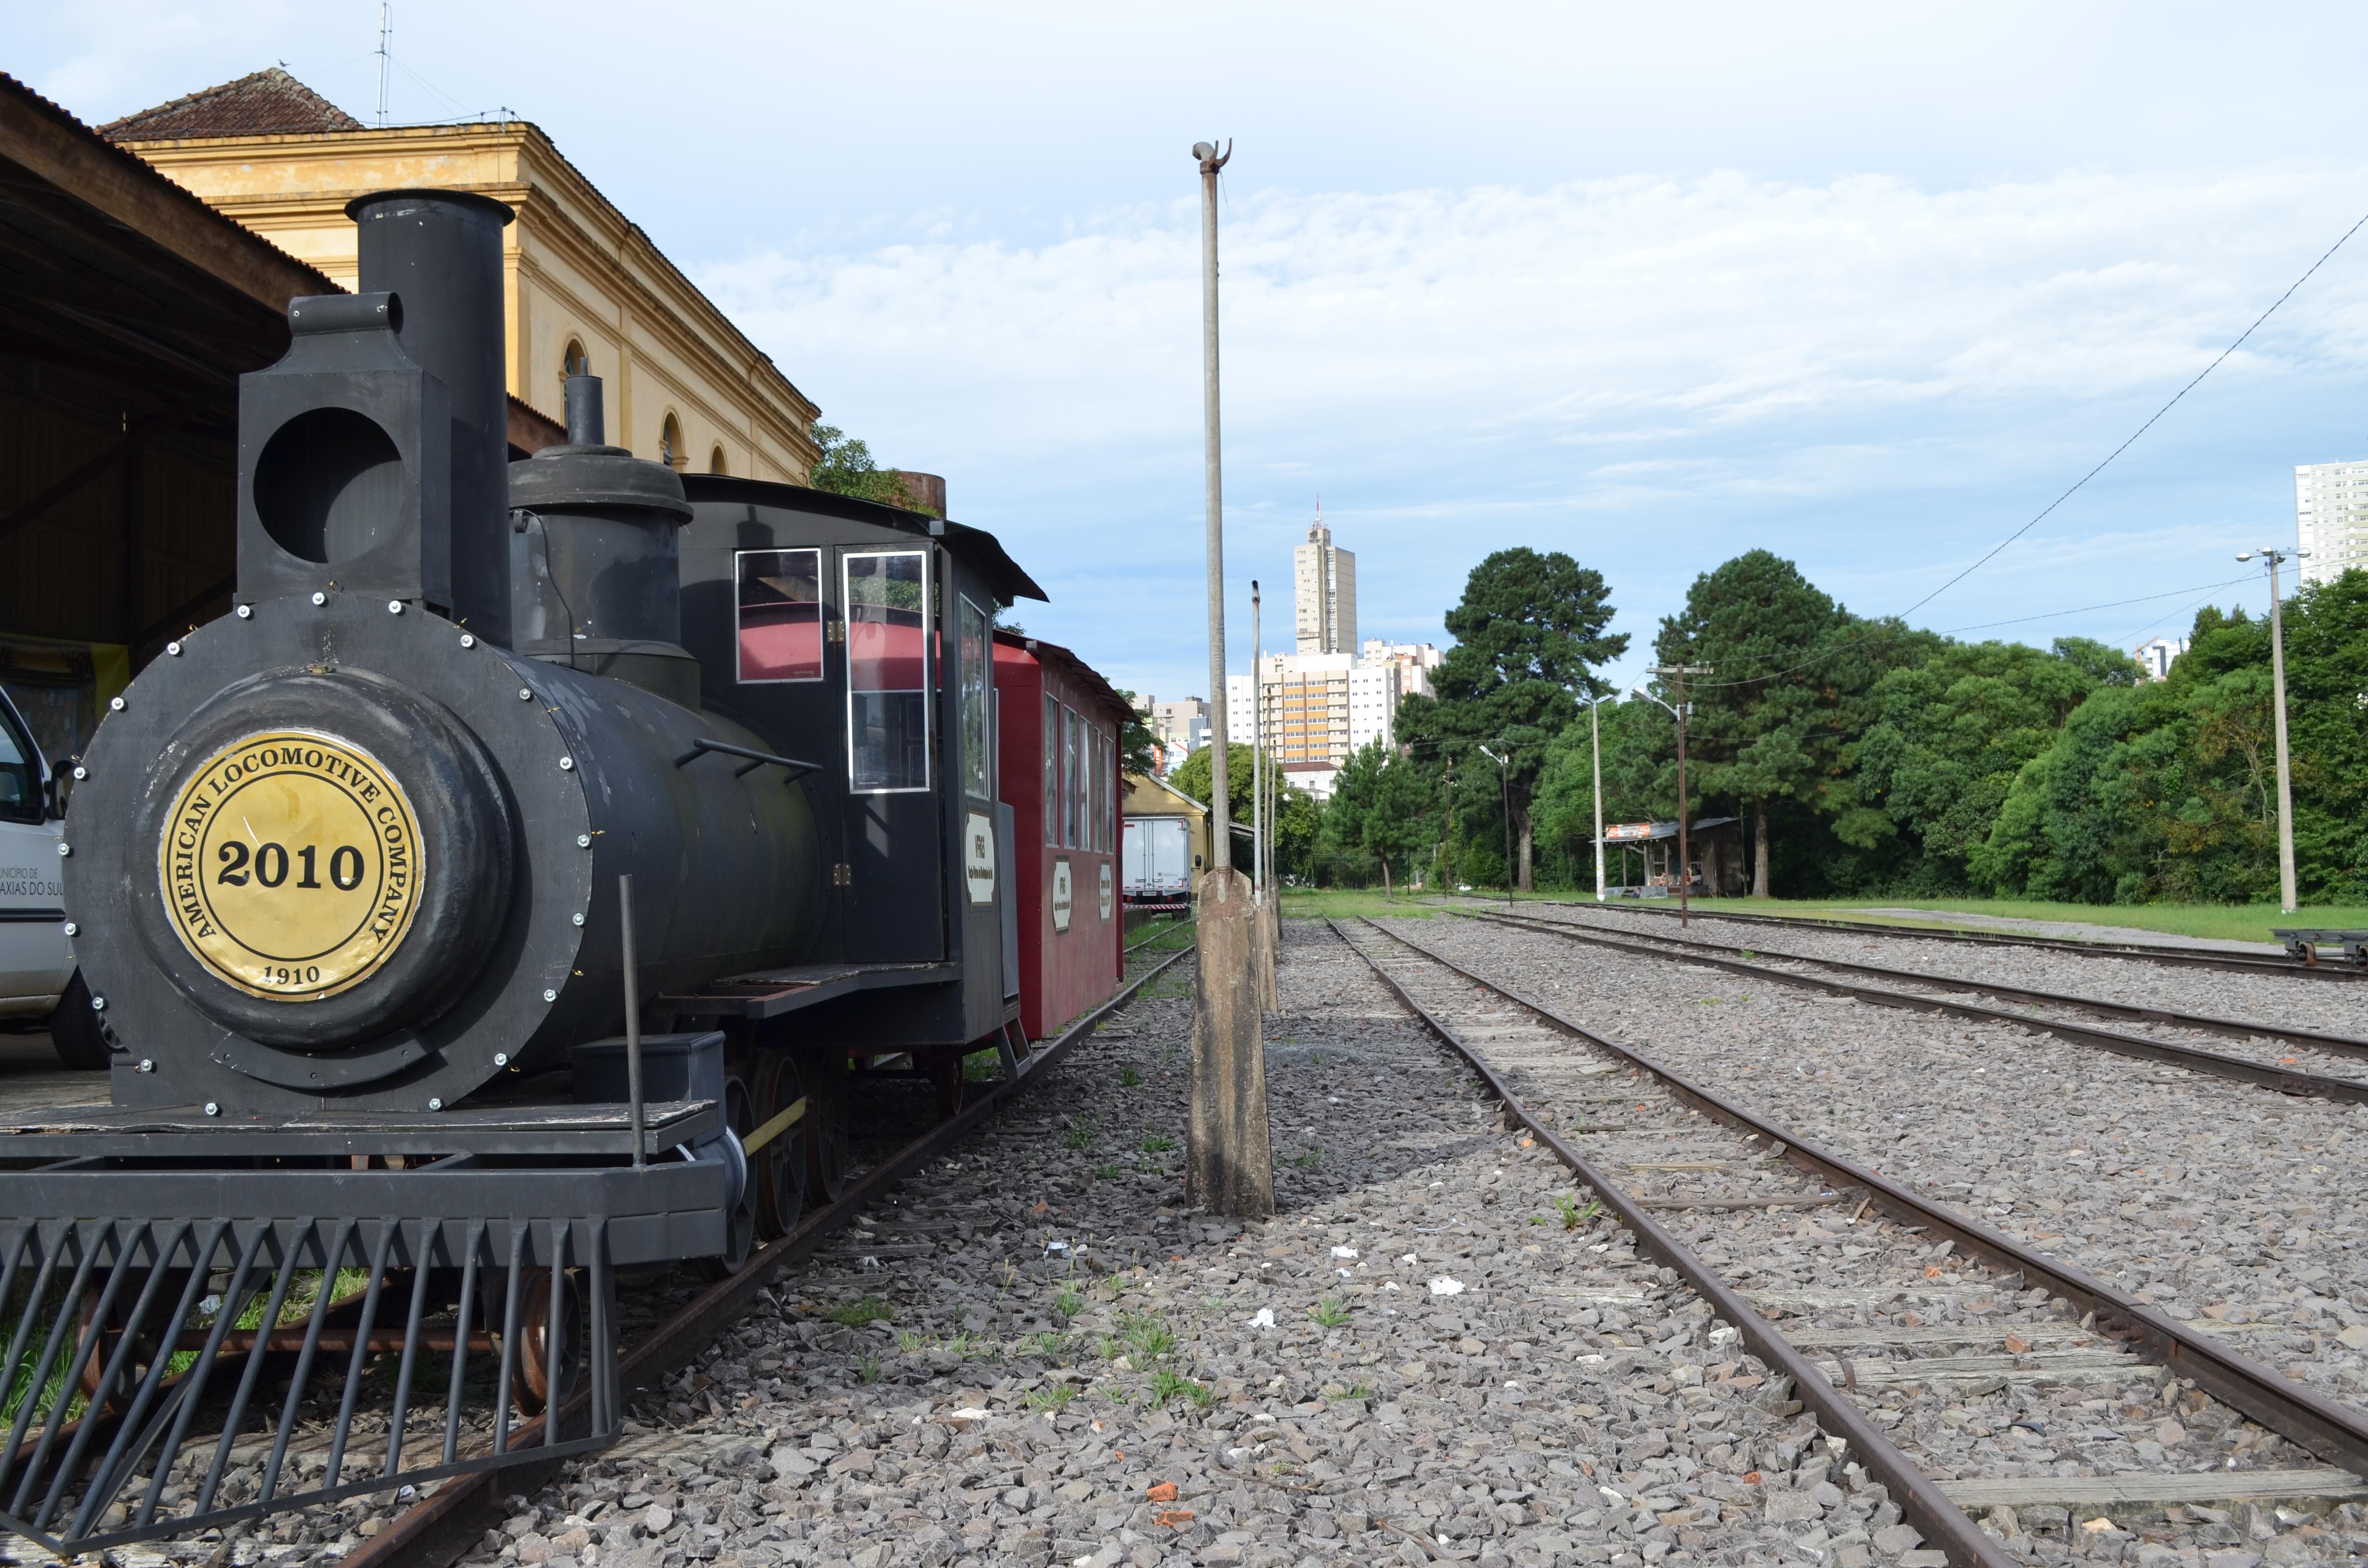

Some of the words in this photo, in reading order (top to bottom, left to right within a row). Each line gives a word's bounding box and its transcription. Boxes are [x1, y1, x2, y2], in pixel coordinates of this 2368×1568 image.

[176, 794, 216, 940] AMERICAN
[208, 747, 381, 804] LOCOMOTIVE
[369, 806, 407, 944] COMPANY
[30, 868, 38, 879] DE
[217, 840, 365, 892] 2010
[30, 882, 45, 895] DO
[48, 882, 63, 895] SUL
[262, 965, 321, 986] 1910
